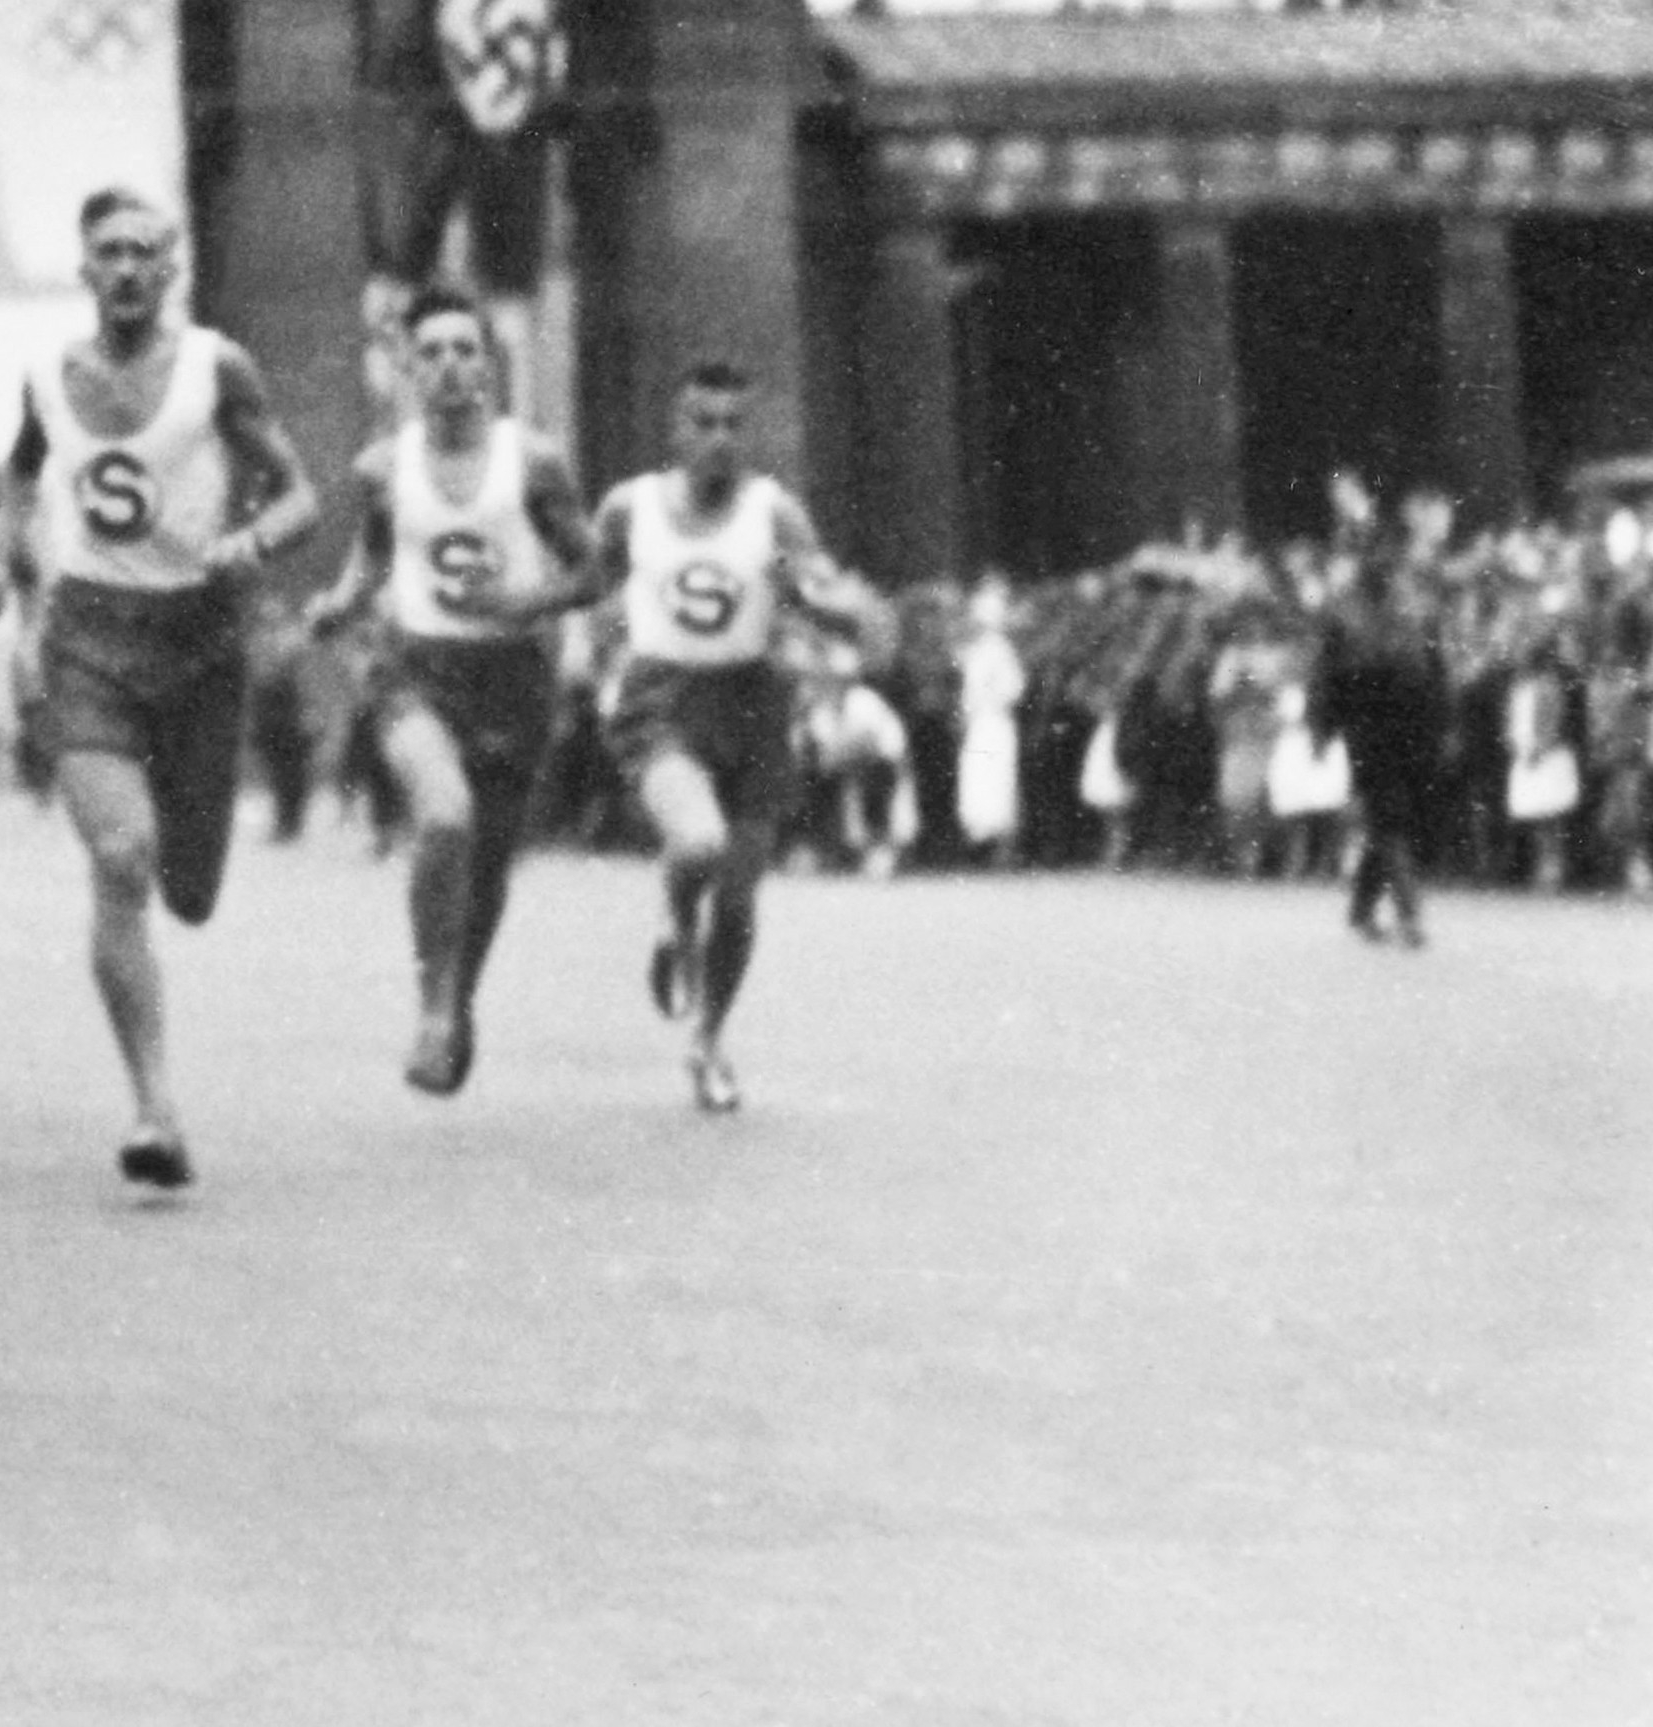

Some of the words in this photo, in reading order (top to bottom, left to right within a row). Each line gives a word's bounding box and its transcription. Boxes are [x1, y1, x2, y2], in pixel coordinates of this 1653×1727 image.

[92, 451, 149, 542] S
[430, 531, 493, 615] S
[677, 562, 738, 635] S
